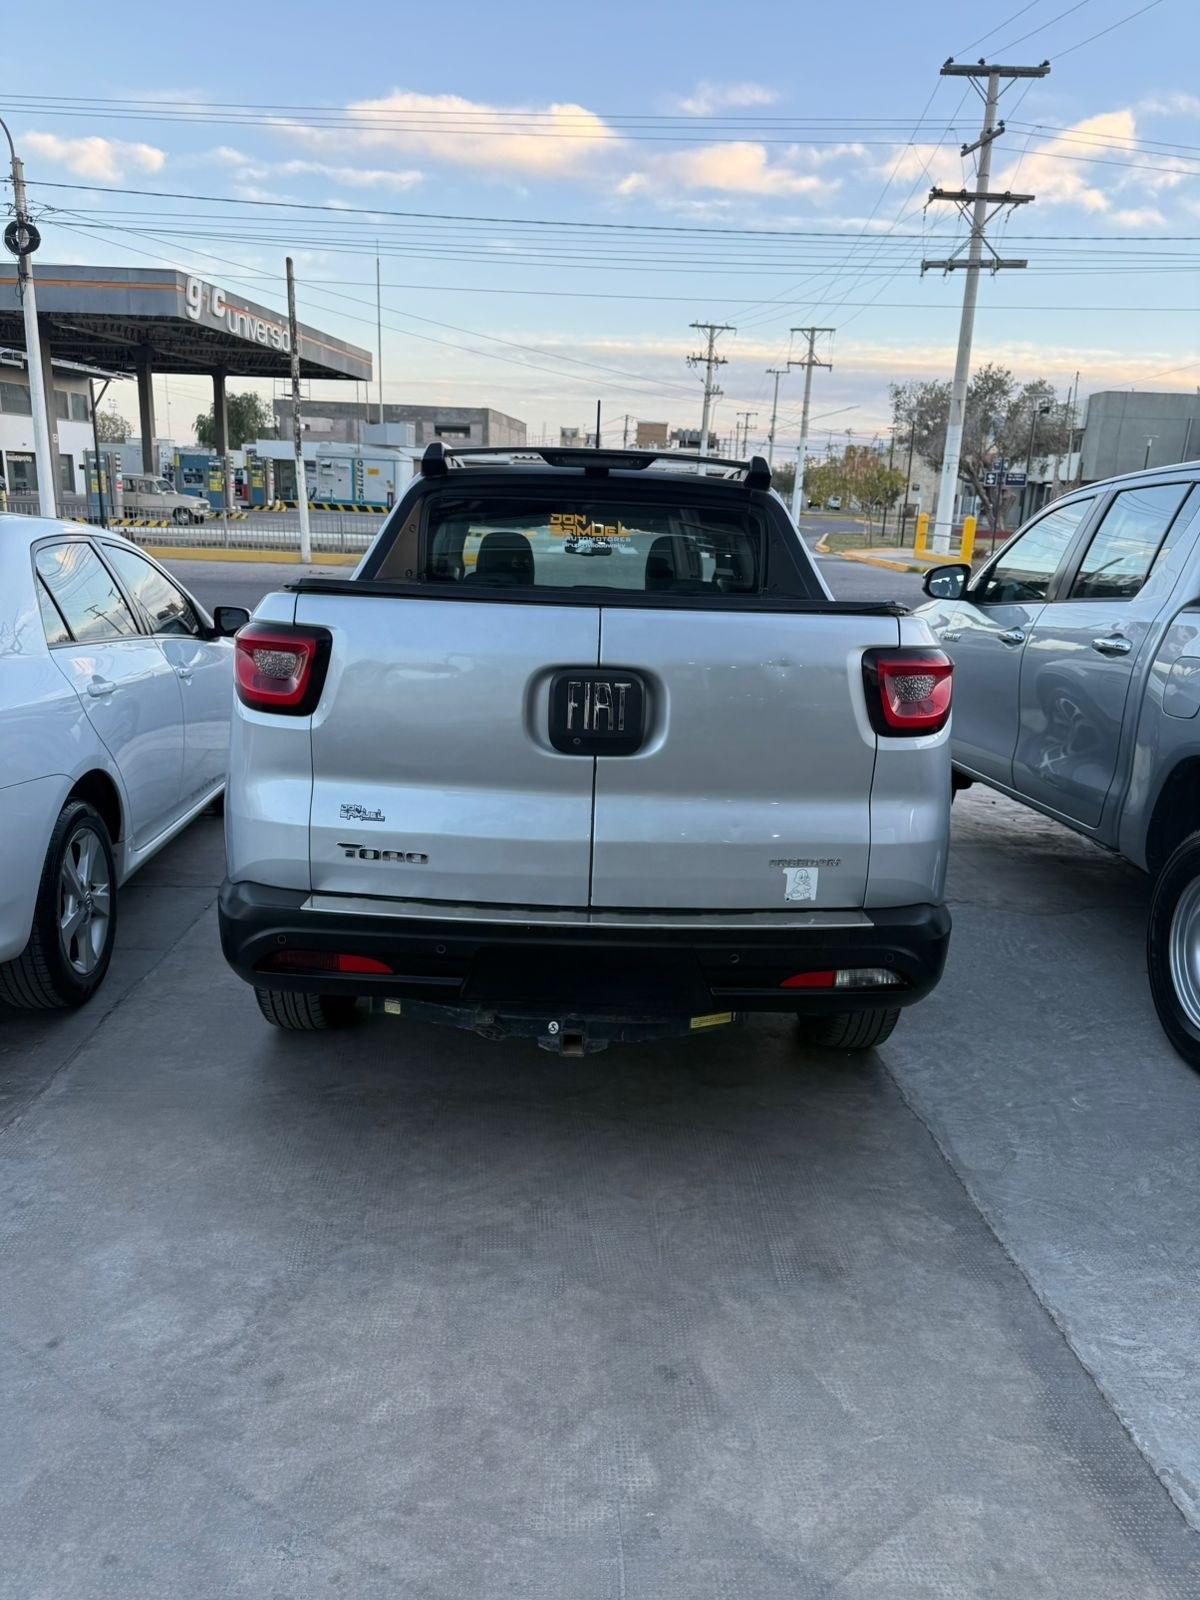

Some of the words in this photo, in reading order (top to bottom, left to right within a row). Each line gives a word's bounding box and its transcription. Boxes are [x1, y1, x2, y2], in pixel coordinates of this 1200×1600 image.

[549, 520, 631, 536] SAMUEL
[550, 513, 586, 524] DON
[567, 681, 631, 731] FIAT
[337, 842, 429, 865] TORO
